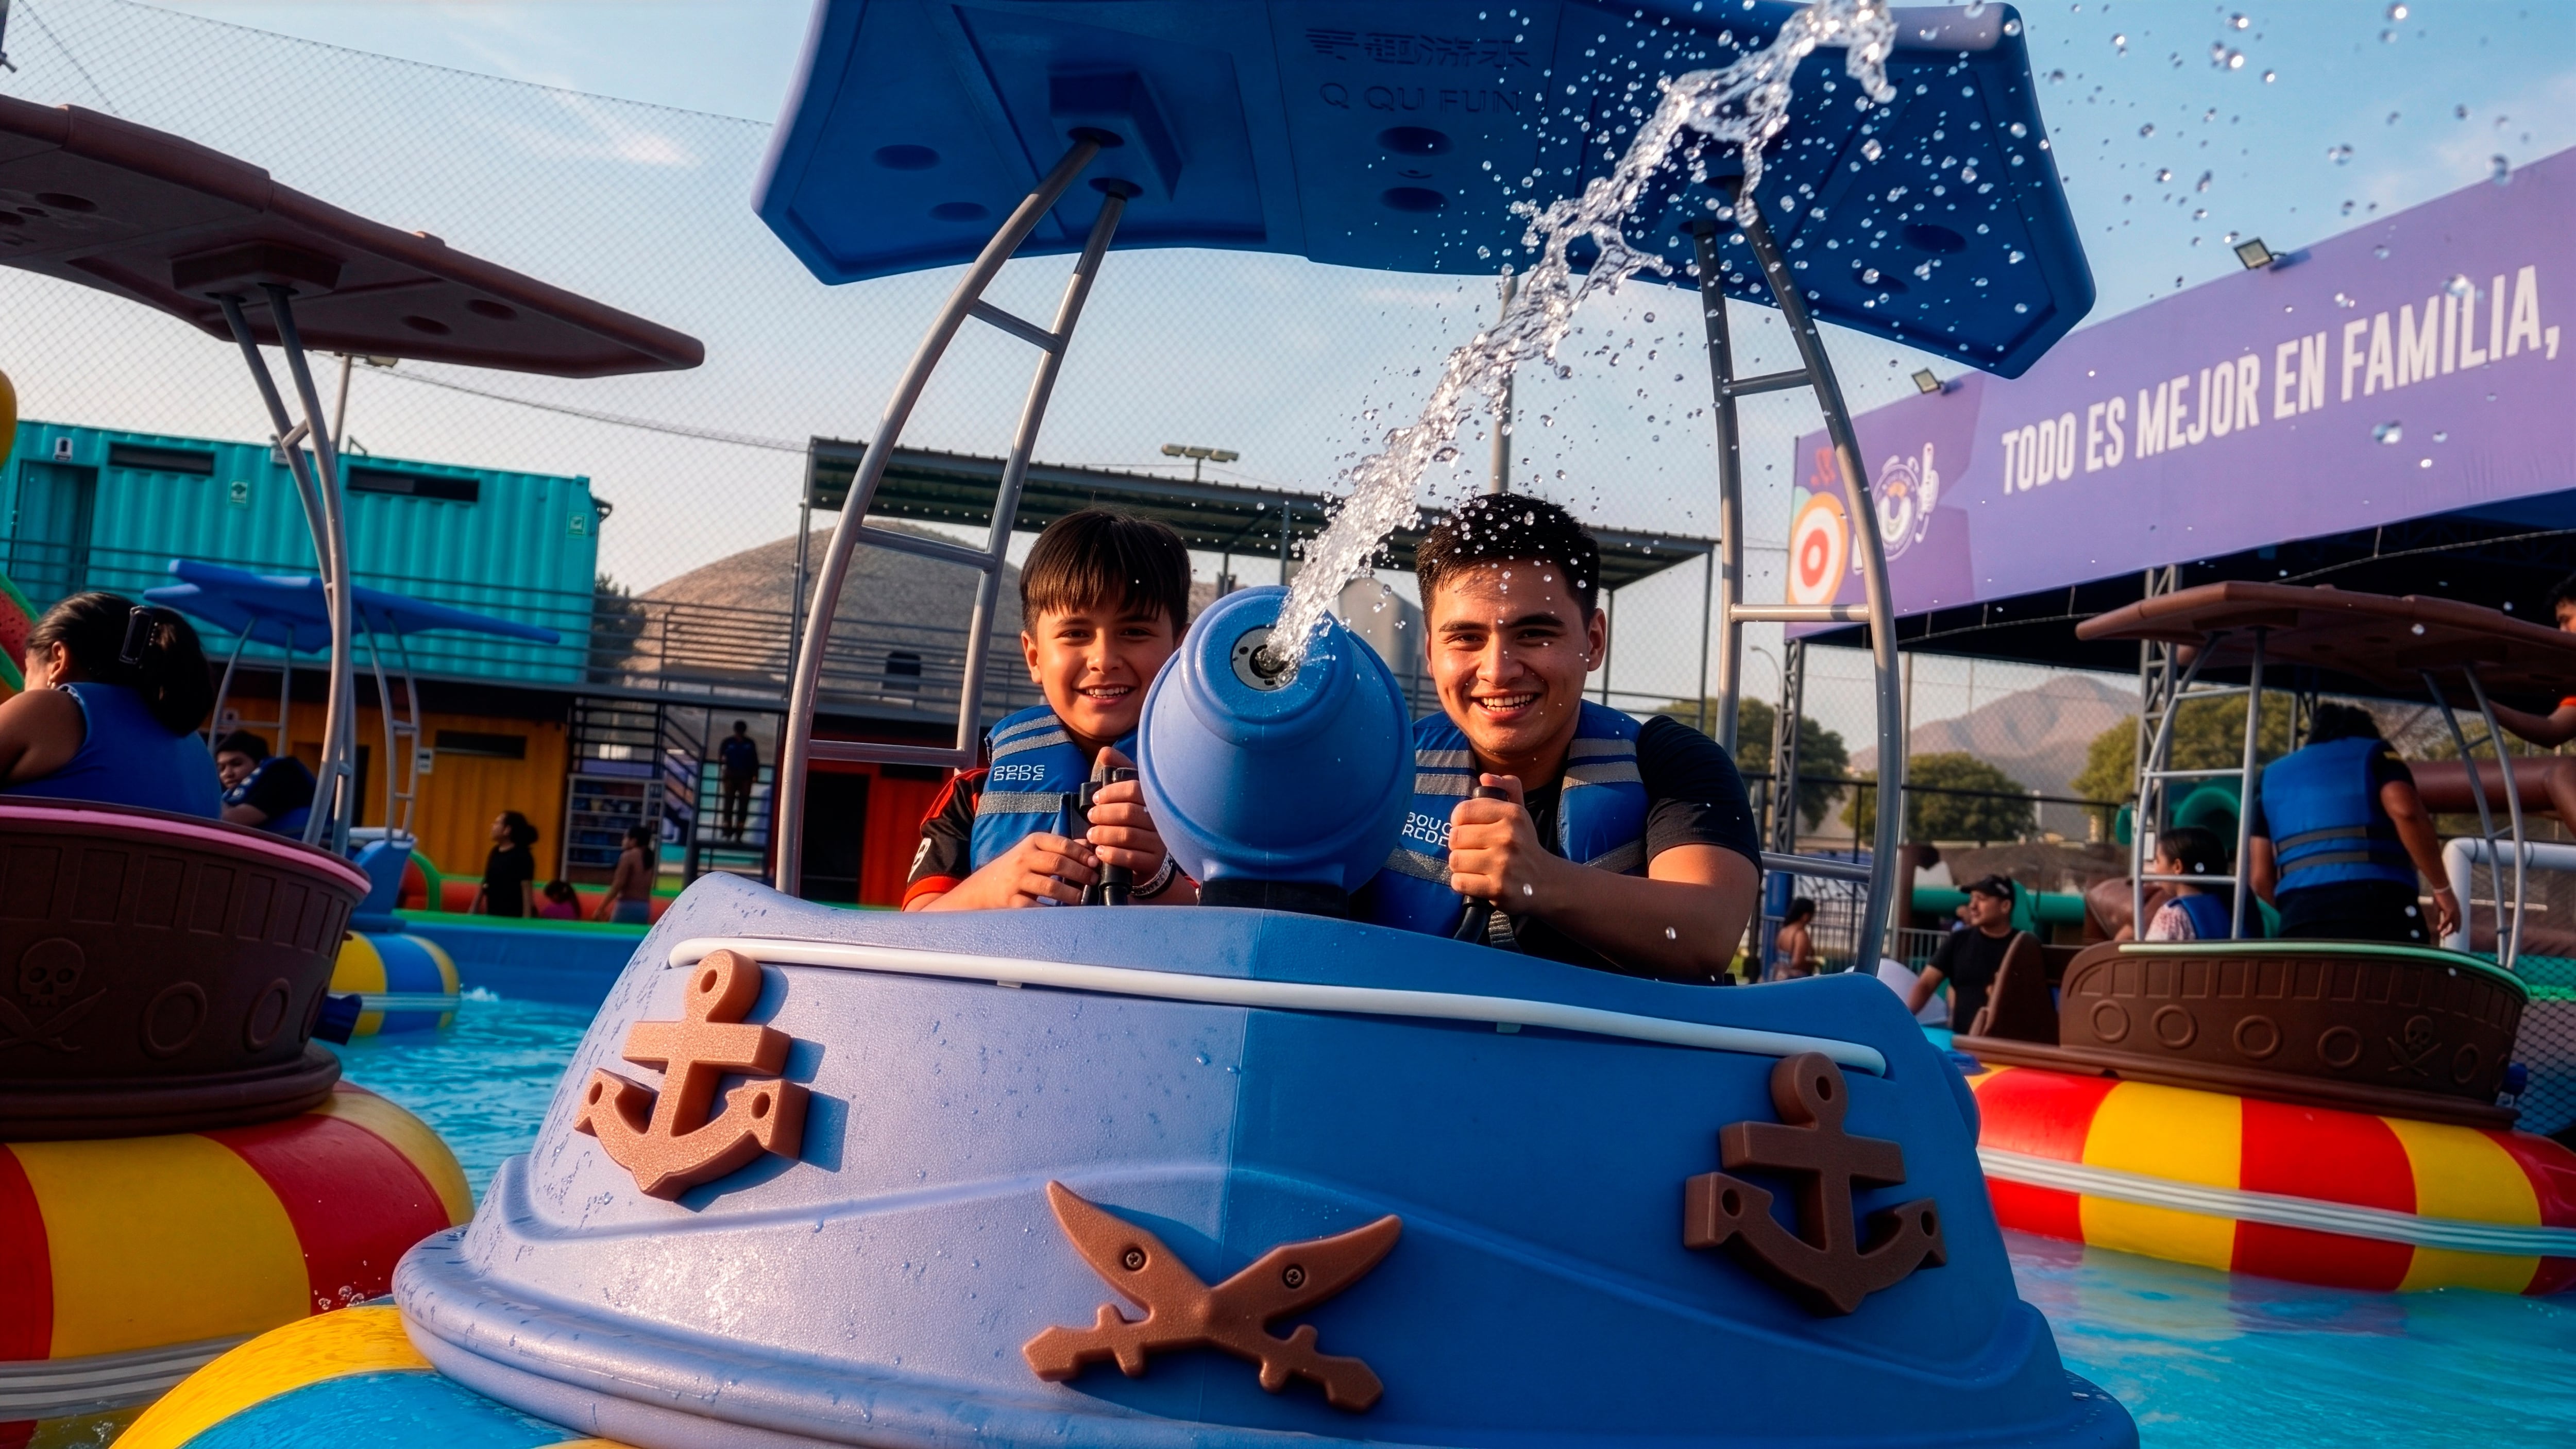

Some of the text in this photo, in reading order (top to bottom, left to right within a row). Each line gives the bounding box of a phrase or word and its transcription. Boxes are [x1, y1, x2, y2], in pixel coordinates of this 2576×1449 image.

[1440, 89, 1519, 112] FUN
[2002, 265, 2560, 495] TODO ES MEJOR EN FAMILIA,
